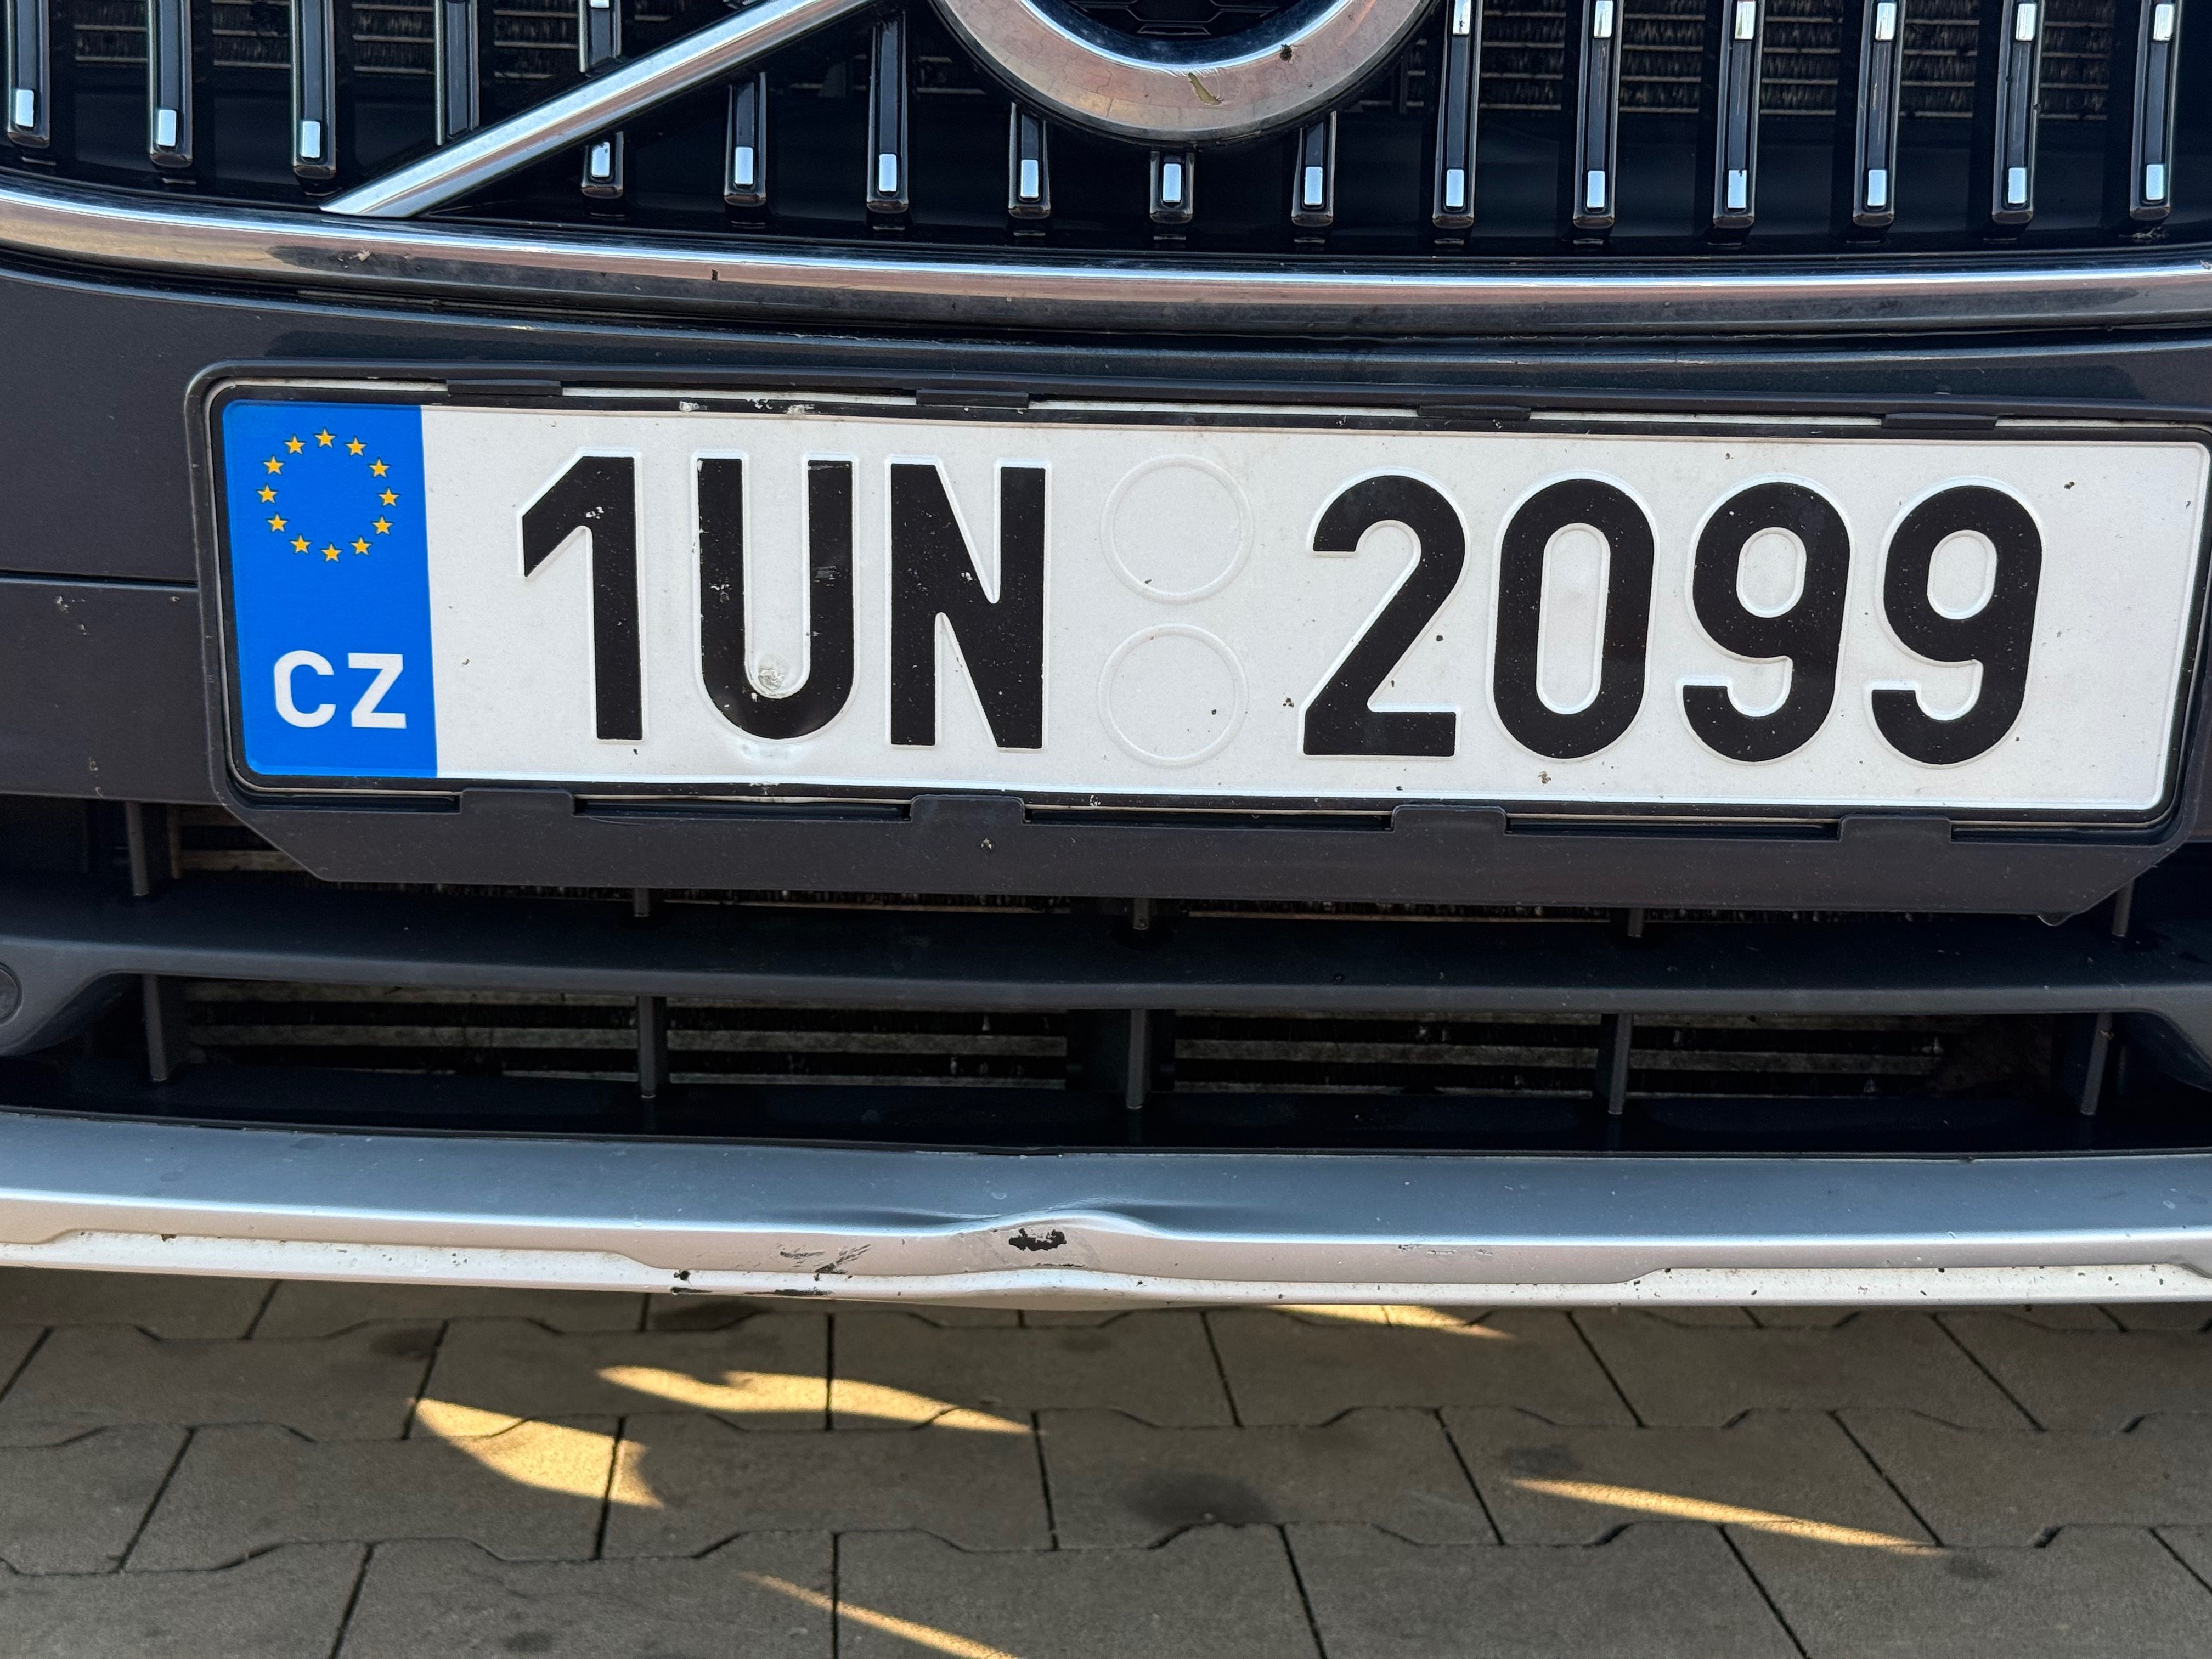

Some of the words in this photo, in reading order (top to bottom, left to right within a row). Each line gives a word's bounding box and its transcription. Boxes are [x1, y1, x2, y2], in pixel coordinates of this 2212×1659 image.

[273, 650, 408, 729] CZ
[522, 456, 1047, 749] 1UN
[1303, 475, 2043, 765] 2099
